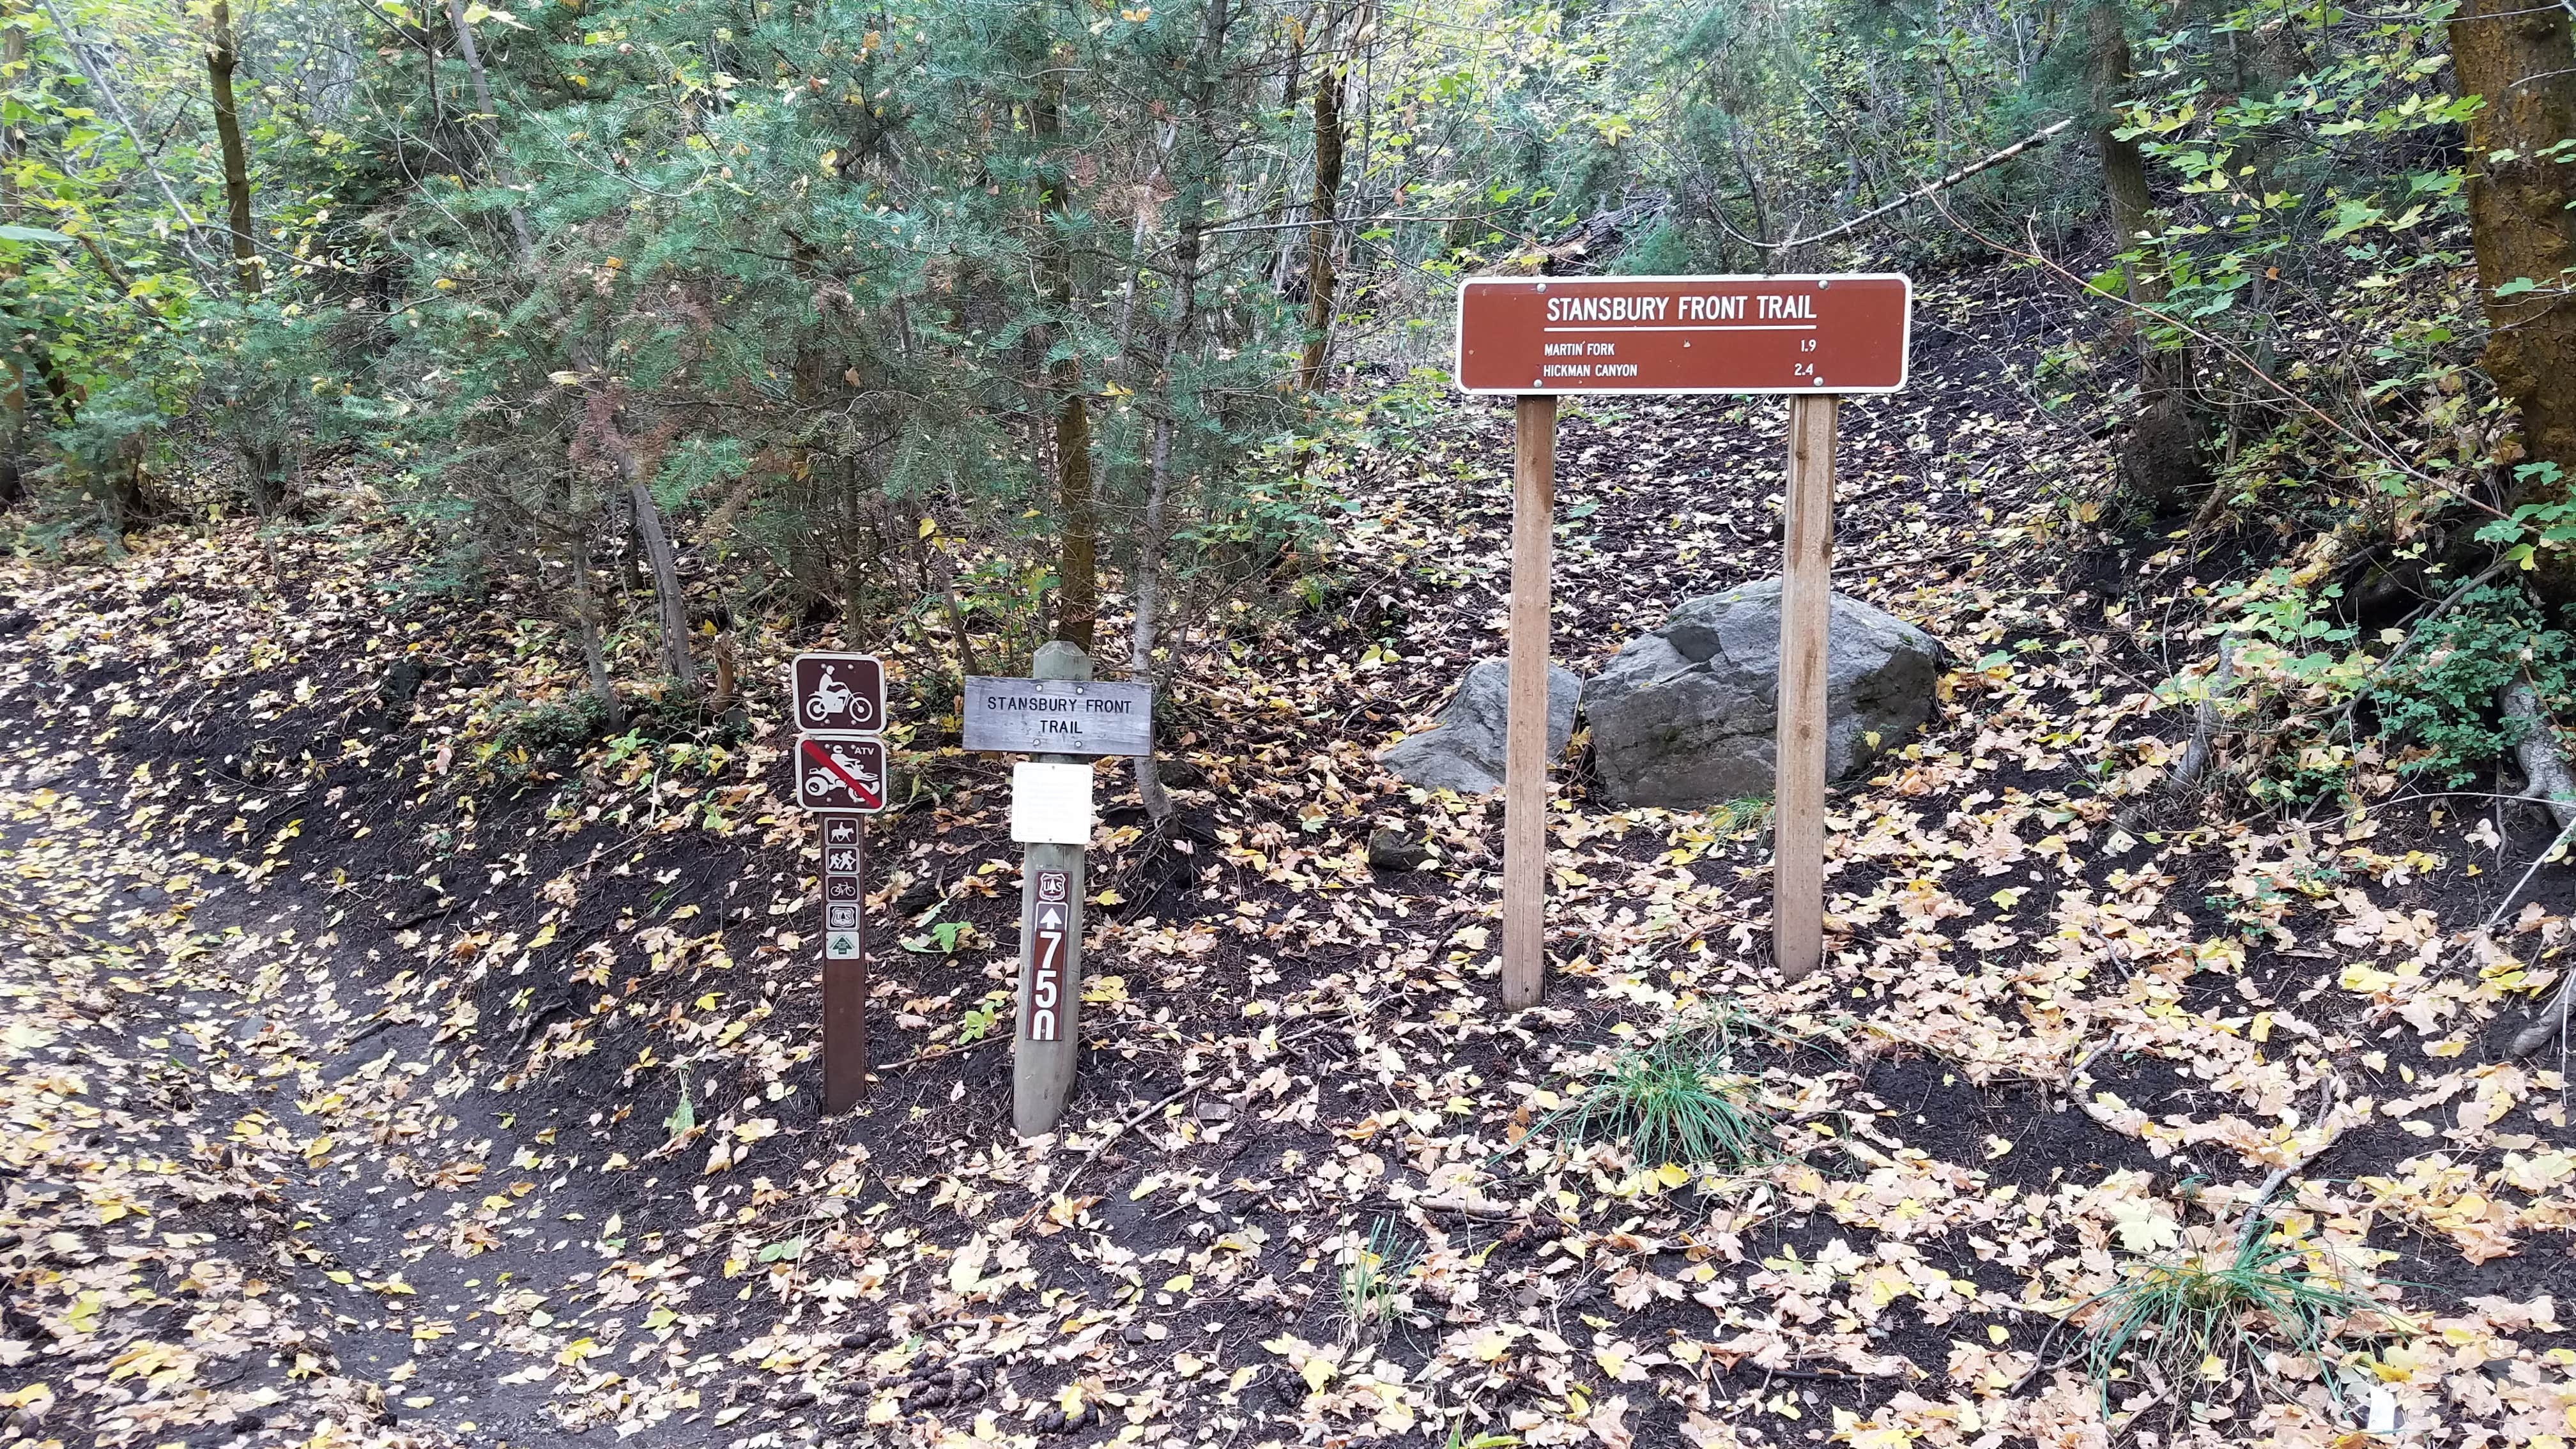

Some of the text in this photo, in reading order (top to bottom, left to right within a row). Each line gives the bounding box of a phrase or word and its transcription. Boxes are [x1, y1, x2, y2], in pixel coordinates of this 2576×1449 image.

[1546, 295, 1817, 321] STANSBURY FRONT TRAIL
[1544, 342, 1615, 356] MARTIN FORK
[1800, 339, 1816, 352] 1.9
[1543, 364, 1637, 377] HICKMAN CANYON
[1794, 363, 1813, 376] 2.4
[987, 696, 1131, 714] STANSBURY FRONT
[1040, 720, 1083, 734] TRAIL
[854, 747, 875, 755] ATV
